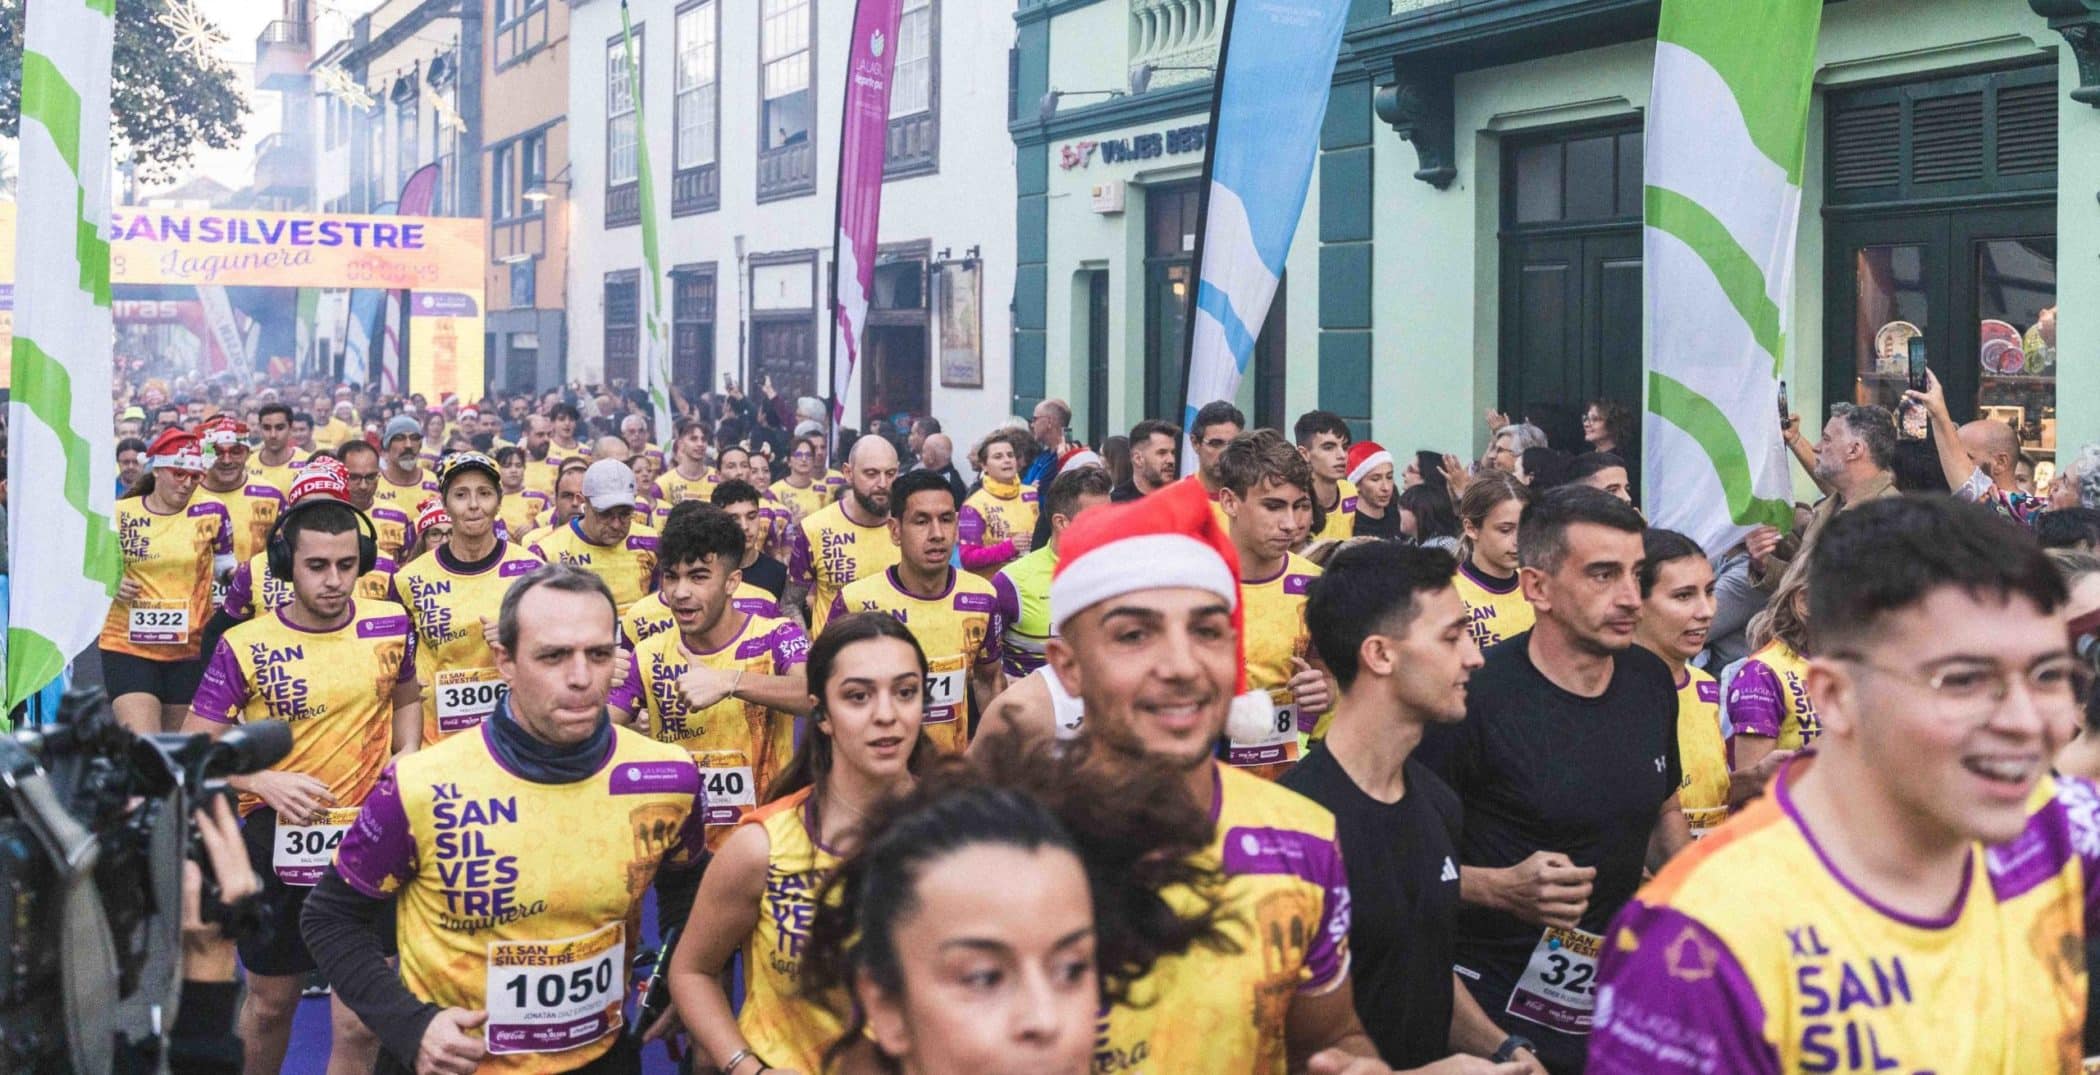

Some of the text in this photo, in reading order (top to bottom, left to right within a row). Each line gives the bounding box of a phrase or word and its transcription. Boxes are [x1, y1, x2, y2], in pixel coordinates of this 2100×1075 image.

[198, 216, 425, 249] SILVESTRE
[160, 248, 315, 281] Lagunera
[119, 528, 142, 540] SIL
[120, 518, 152, 530] SAN
[120, 537, 151, 550] VES
[822, 532, 856, 548] SAN
[822, 548, 848, 560] SIL
[824, 558, 857, 572] VES
[827, 571, 856, 584] TRE
[410, 580, 452, 600] SAN
[413, 598, 440, 612] SIL
[862, 600, 880, 611] XL
[134, 611, 184, 627] 3322
[418, 607, 452, 624] VES
[633, 616, 649, 626] XL
[636, 618, 674, 641] SAN
[250, 642, 270, 656] XL
[252, 644, 305, 670] SAN
[255, 665, 293, 687] SIL
[258, 678, 309, 701] VES
[444, 682, 508, 708] 3806
[264, 698, 309, 718] TRE
[431, 783, 464, 802] XL
[433, 796, 518, 830] SAN
[435, 830, 496, 860] SIL
[436, 855, 519, 888] VES
[440, 886, 517, 918] TRE
[497, 945, 549, 956] XL SAN
[1785, 925, 1830, 957] XL
[495, 952, 575, 967] SILVESTRE
[505, 957, 613, 1009] 1050
[1796, 955, 1913, 1017] SAN
[1797, 1020, 1900, 1074] SIL
